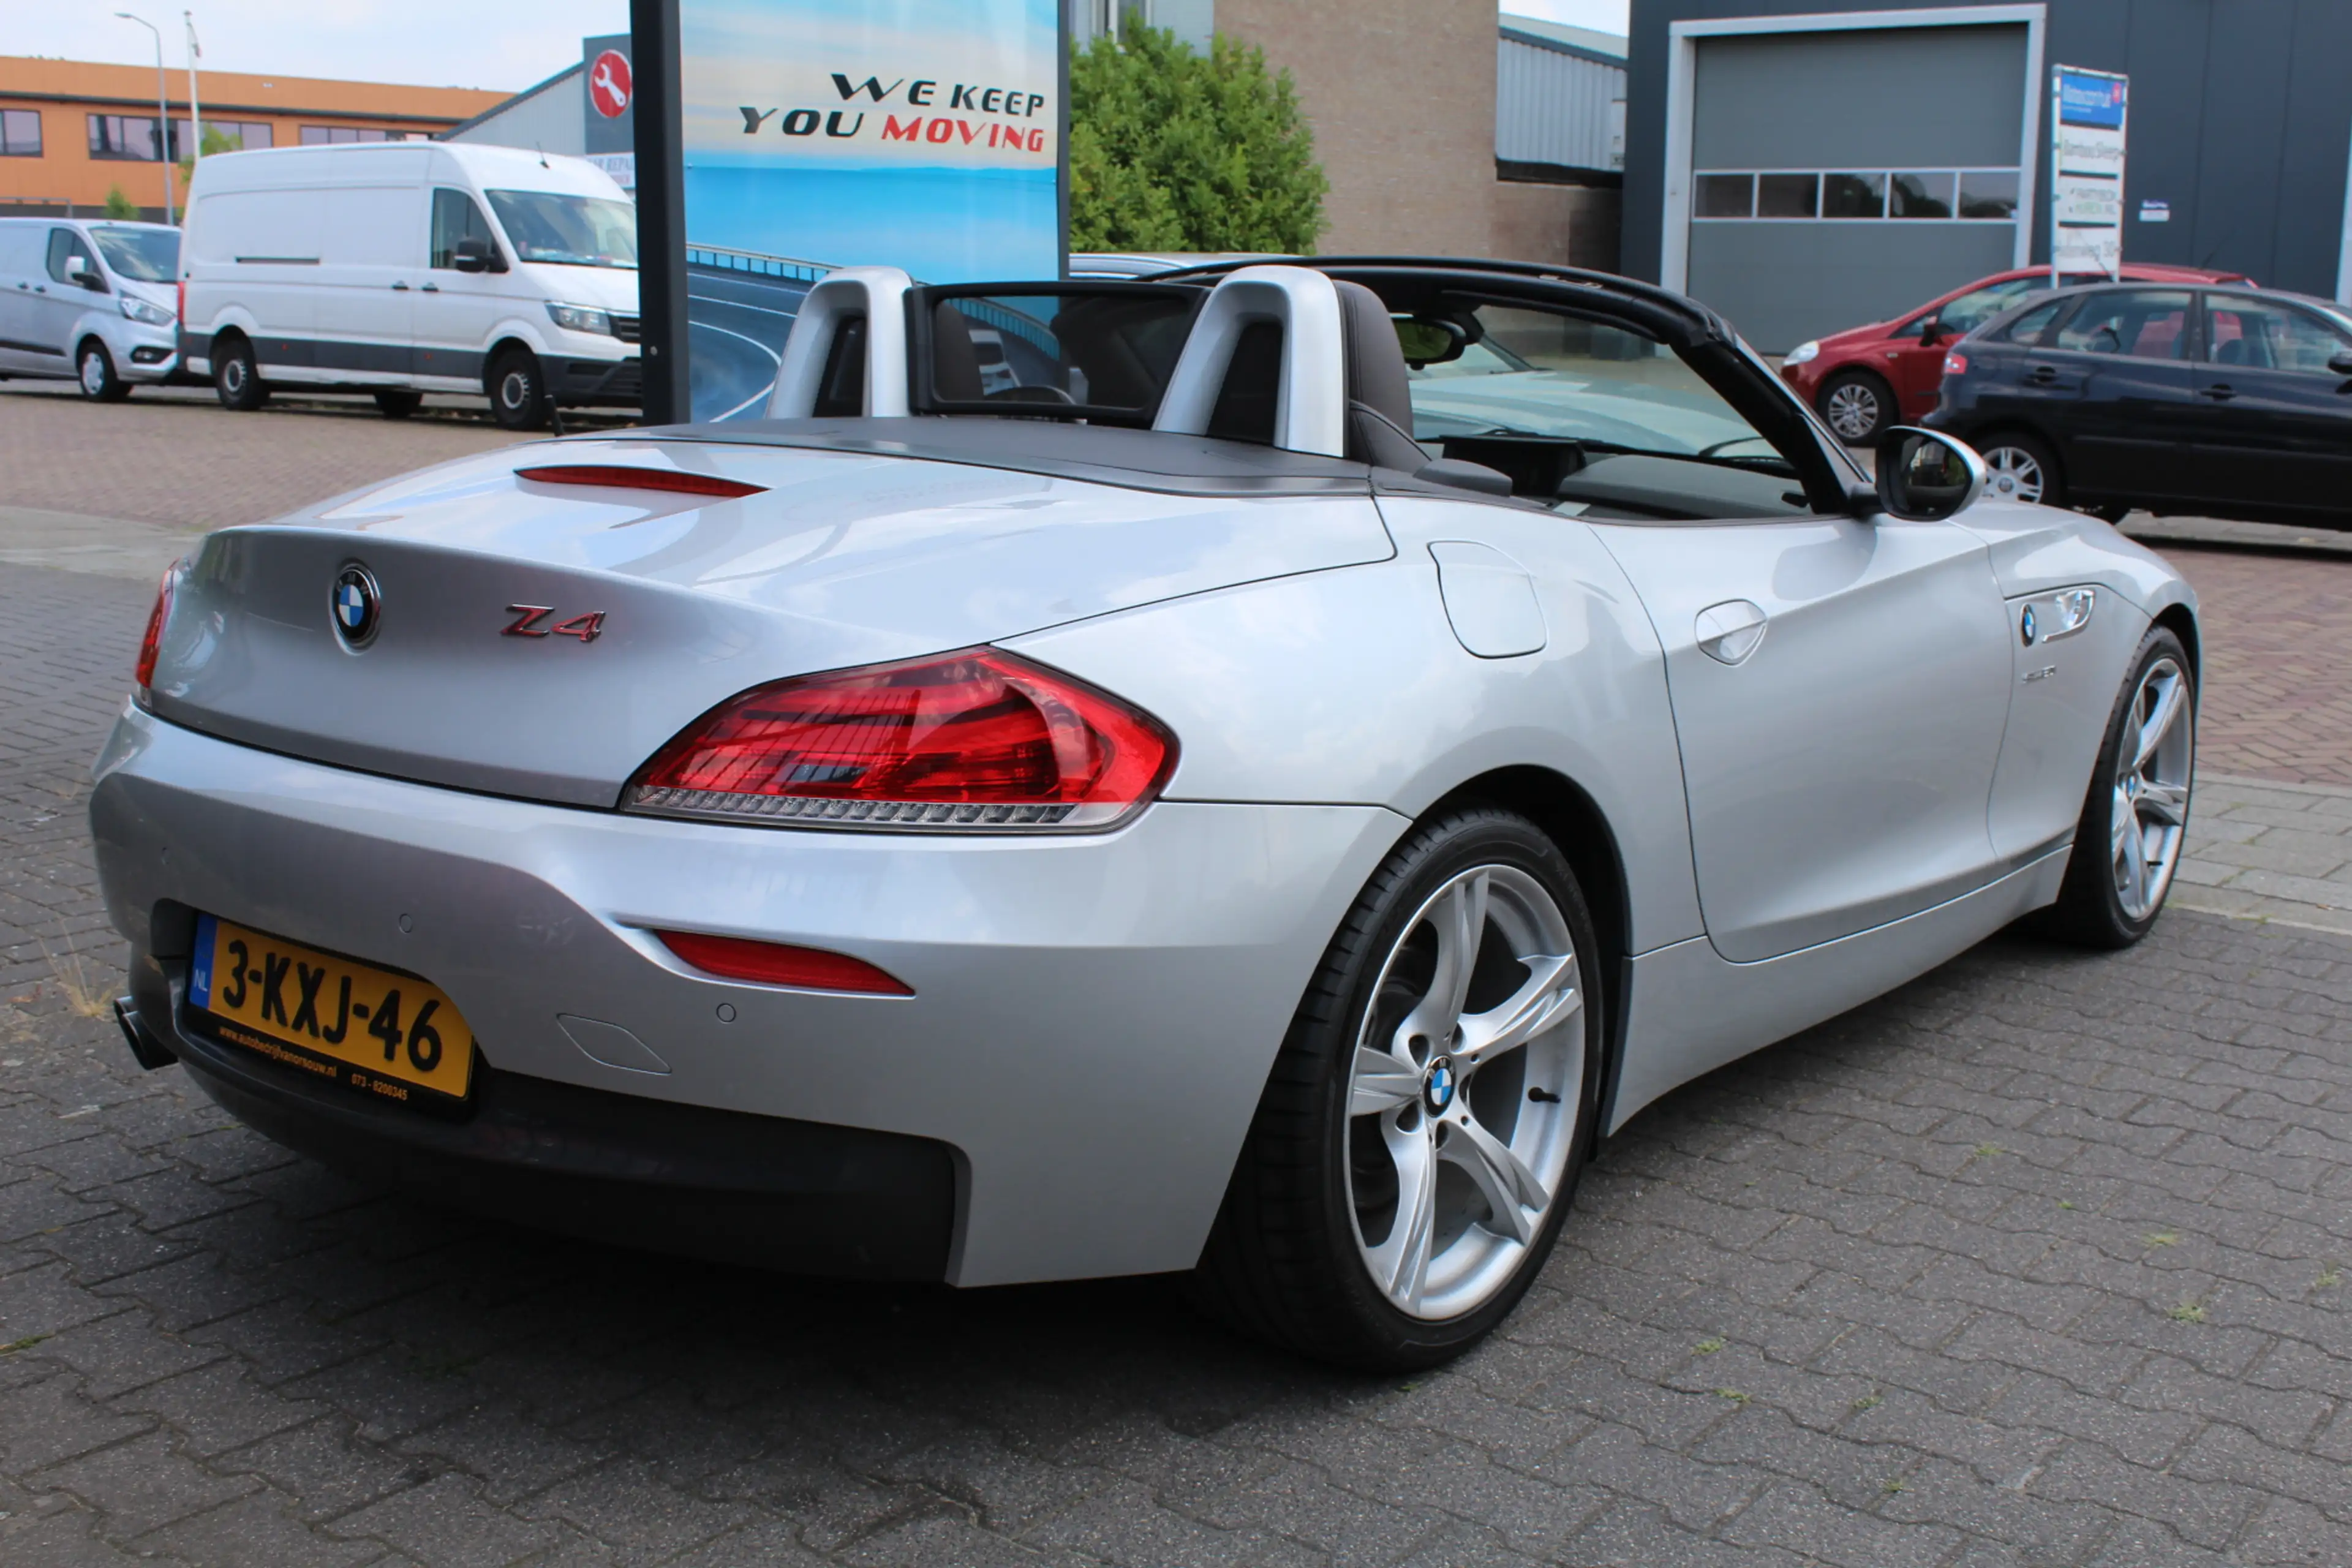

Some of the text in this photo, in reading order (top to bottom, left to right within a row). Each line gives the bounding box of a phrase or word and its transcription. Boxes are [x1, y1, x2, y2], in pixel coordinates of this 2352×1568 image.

[831, 73, 1045, 118] WE KEEP
[739, 107, 1046, 153] YOU MOVING
[500, 603, 606, 643] Z4
[193, 968, 208, 992] NL
[223, 939, 443, 1073] 3-KXJ-46
